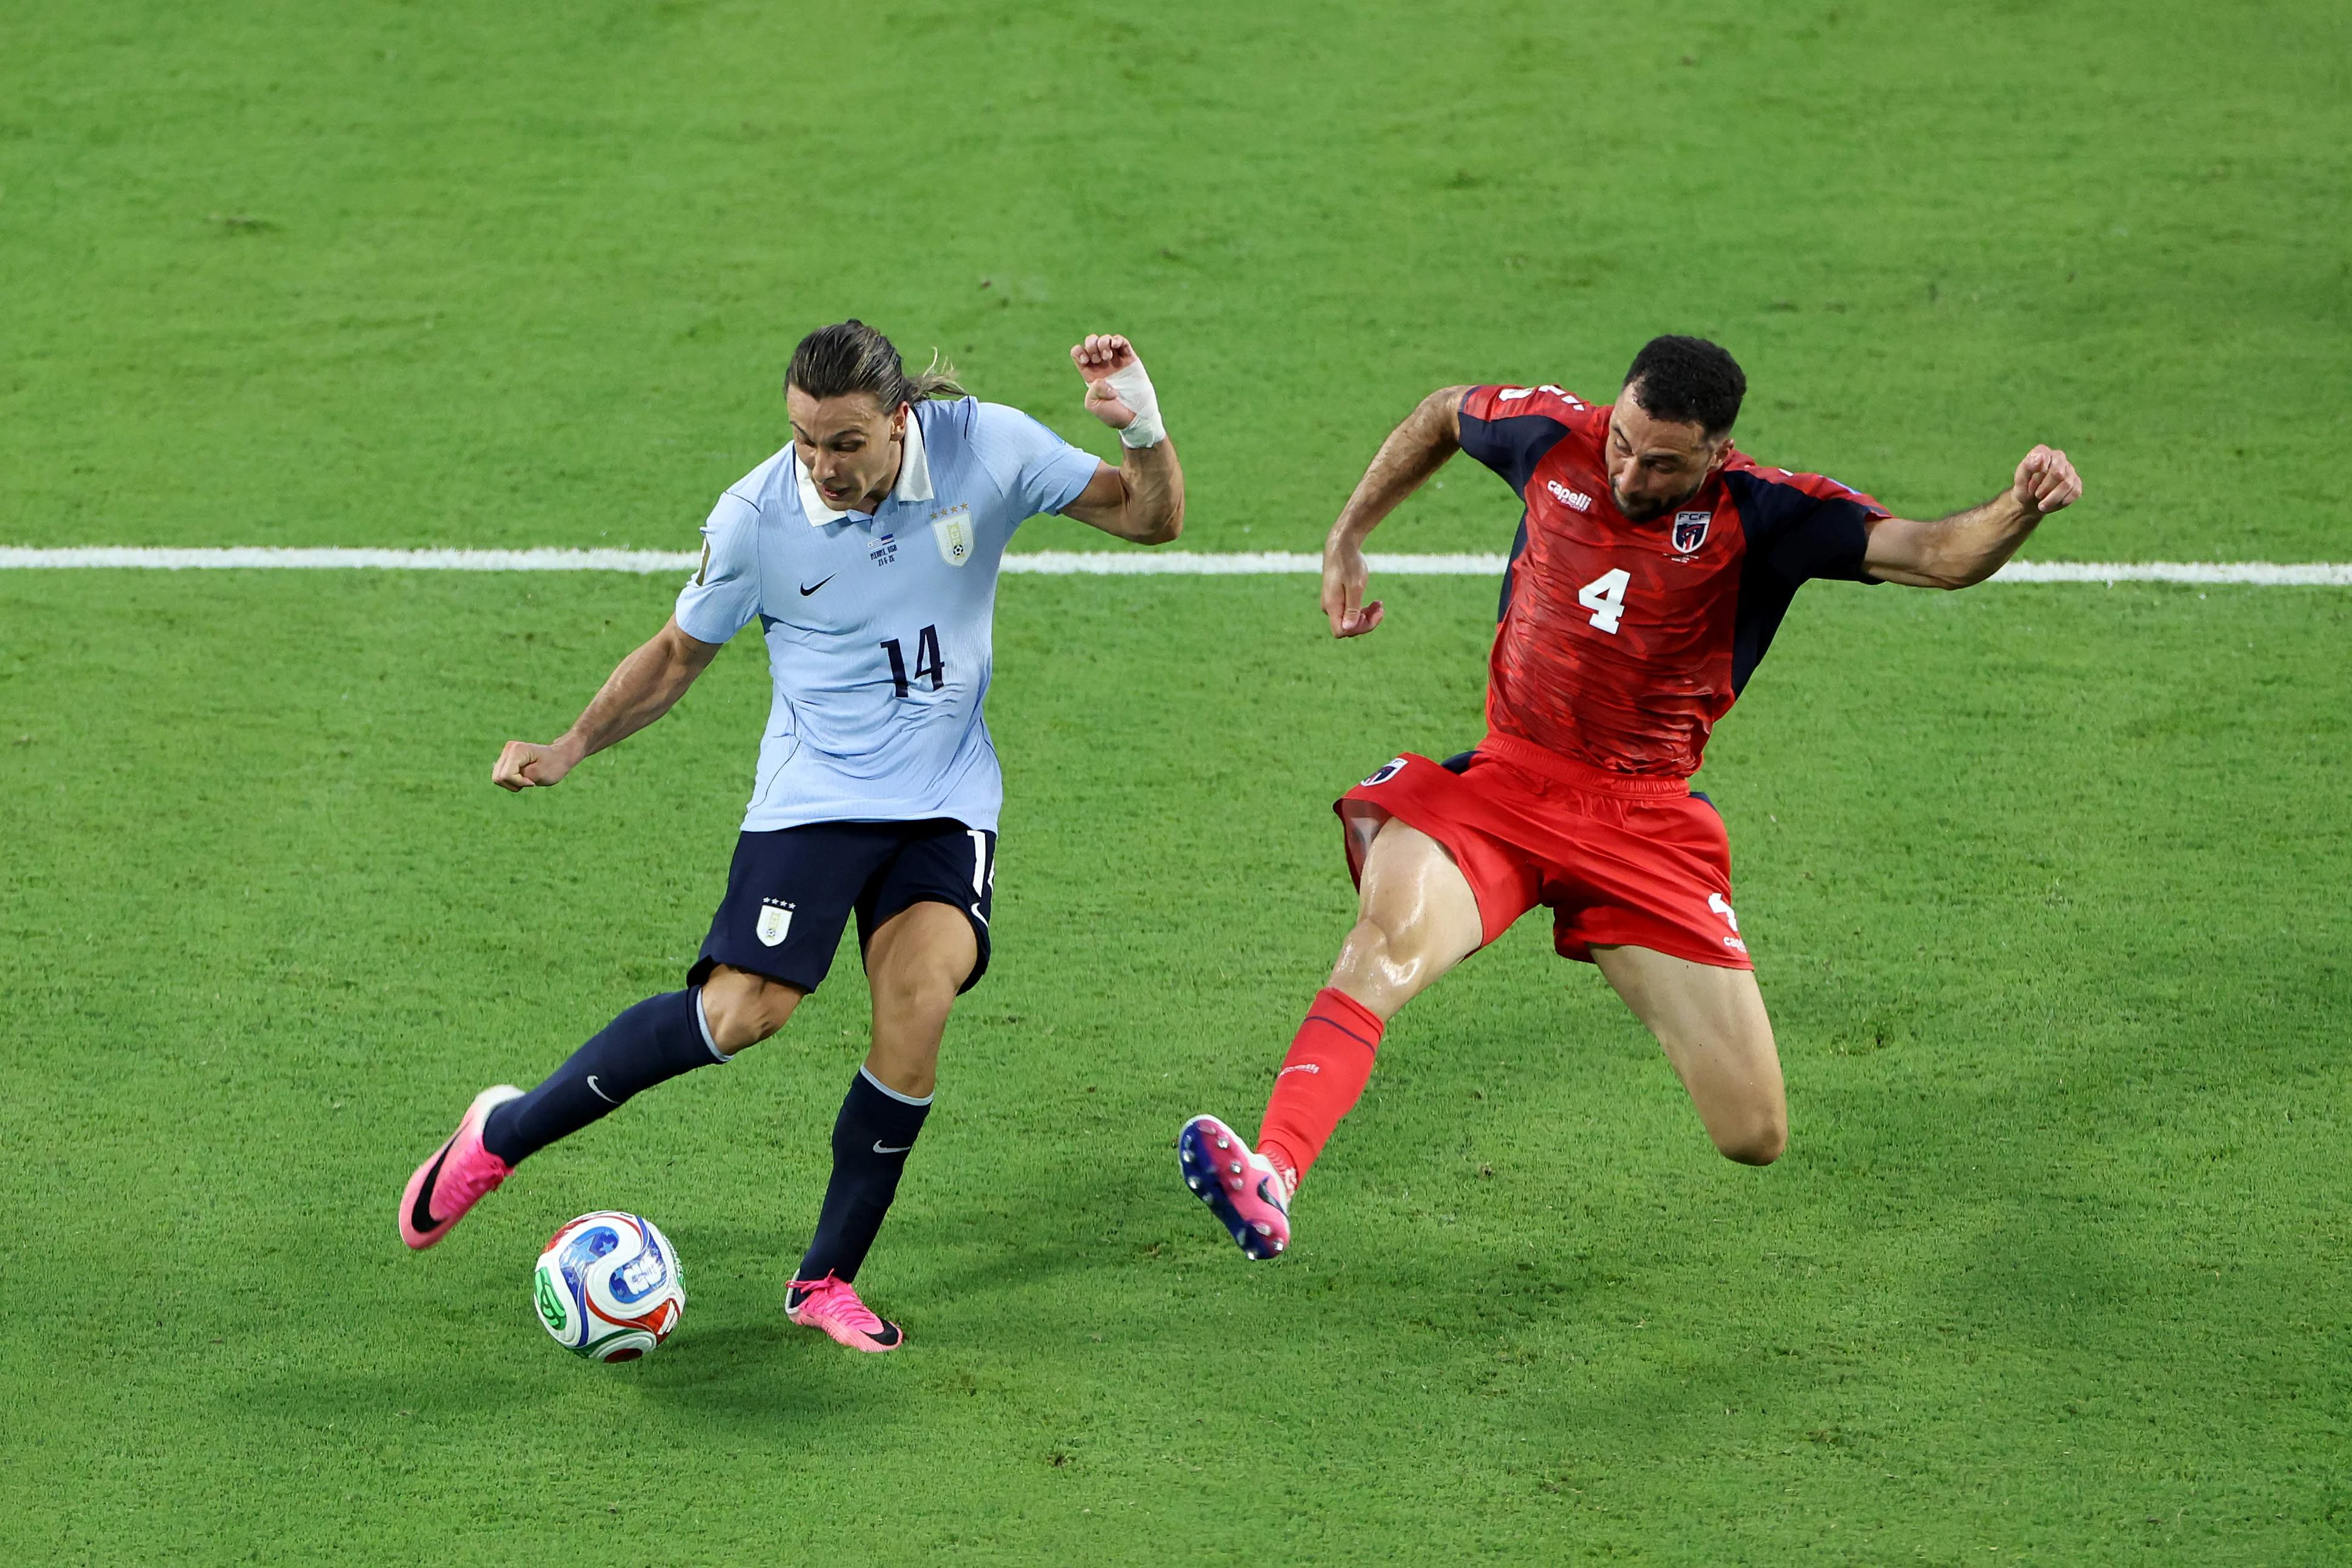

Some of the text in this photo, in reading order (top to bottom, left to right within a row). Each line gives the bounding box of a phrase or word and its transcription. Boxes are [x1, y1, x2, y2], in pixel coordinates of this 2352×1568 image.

[1547, 480, 1592, 511] capelli
[1579, 568, 1631, 635] 4
[880, 624, 945, 698] 14
[967, 830, 995, 898] 1
